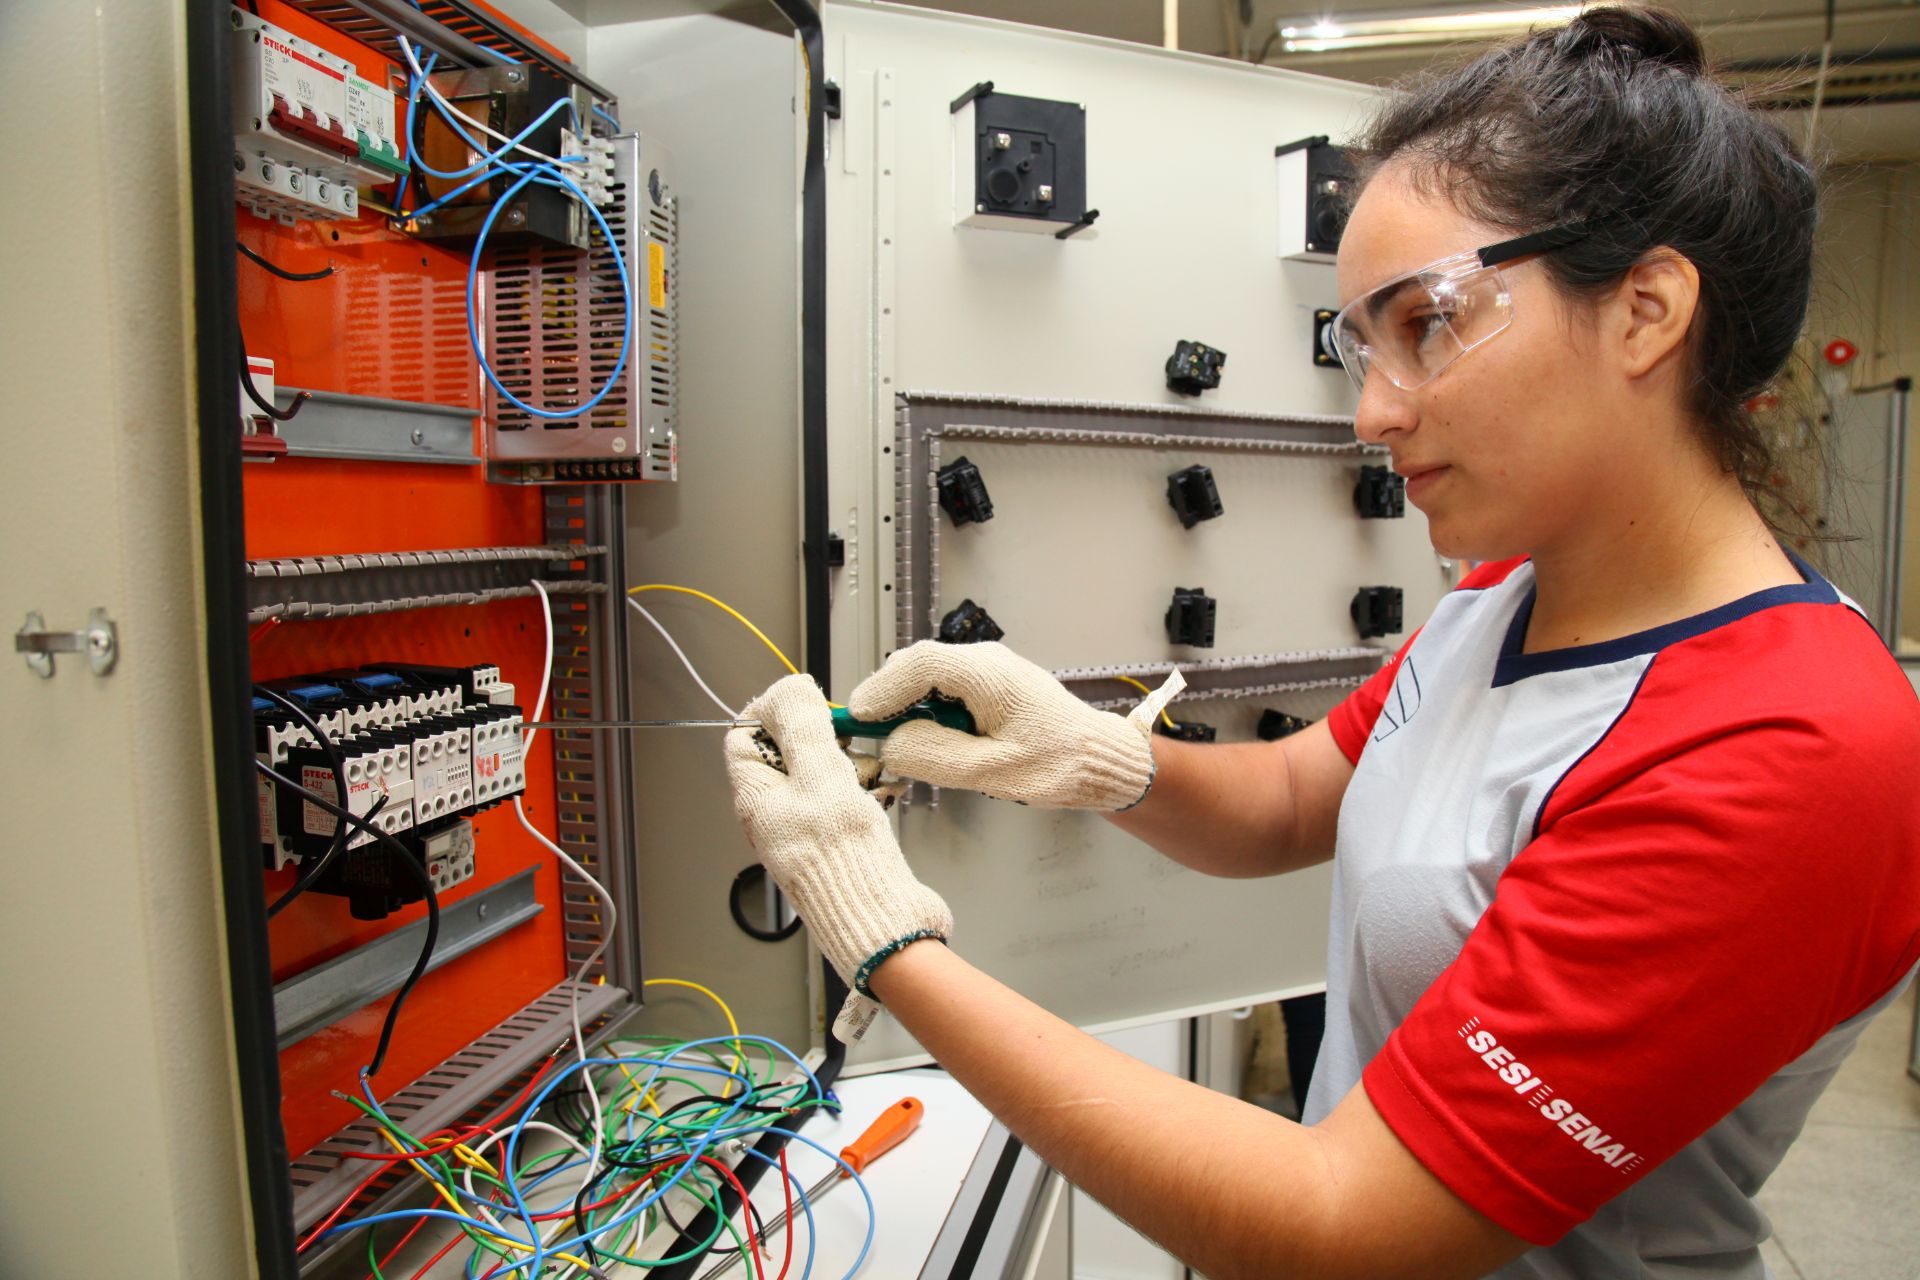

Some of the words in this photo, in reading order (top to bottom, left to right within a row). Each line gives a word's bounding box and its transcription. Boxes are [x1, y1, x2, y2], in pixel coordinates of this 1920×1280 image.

[263, 36, 291, 57] STECK
[303, 769, 335, 780] STECK
[350, 781, 370, 794] STECK
[1467, 1030, 1542, 1095] SESI
[1540, 1098, 1636, 1168] SENAI
